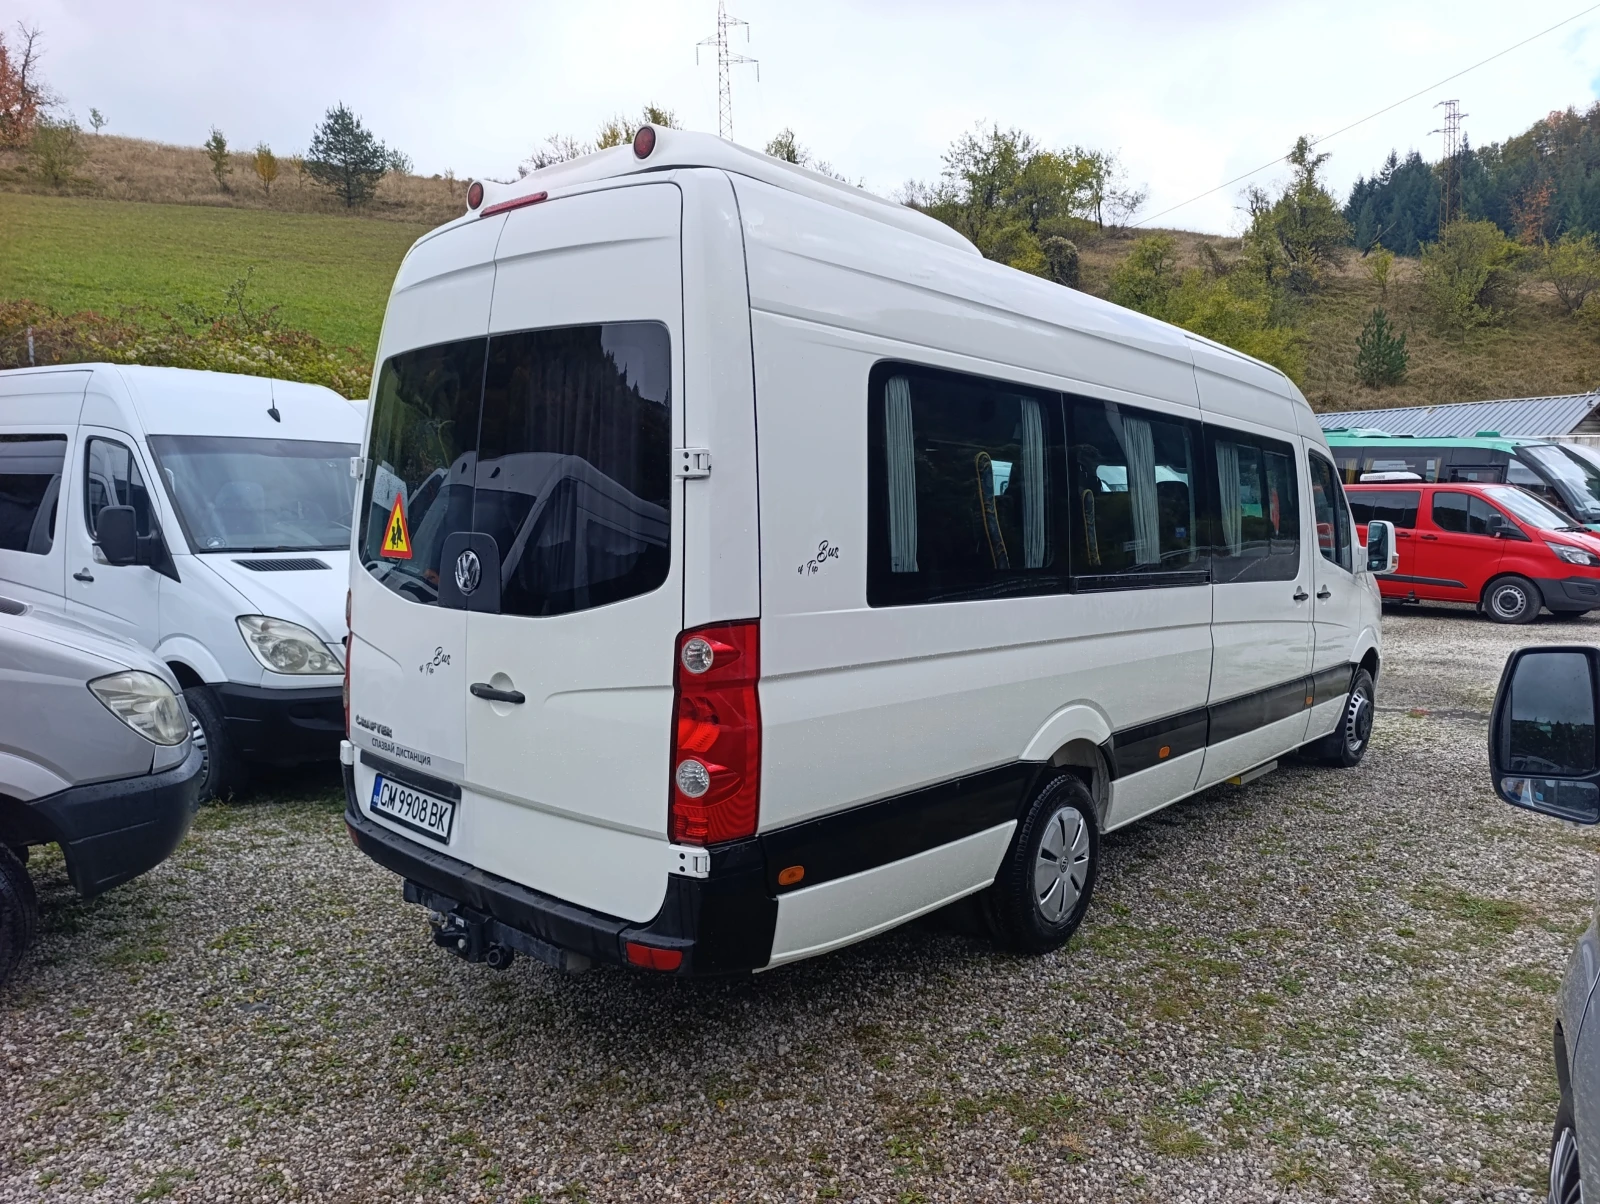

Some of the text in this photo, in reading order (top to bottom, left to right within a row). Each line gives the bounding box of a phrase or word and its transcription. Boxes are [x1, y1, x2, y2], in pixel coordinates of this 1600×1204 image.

[817, 539, 839, 563] Bus
[432, 646, 451, 666] Bus
[371, 738, 432, 767] СПАЗВАЙ ДИСТАНЦИЯ
[380, 783, 448, 832] CM 9908 BK
